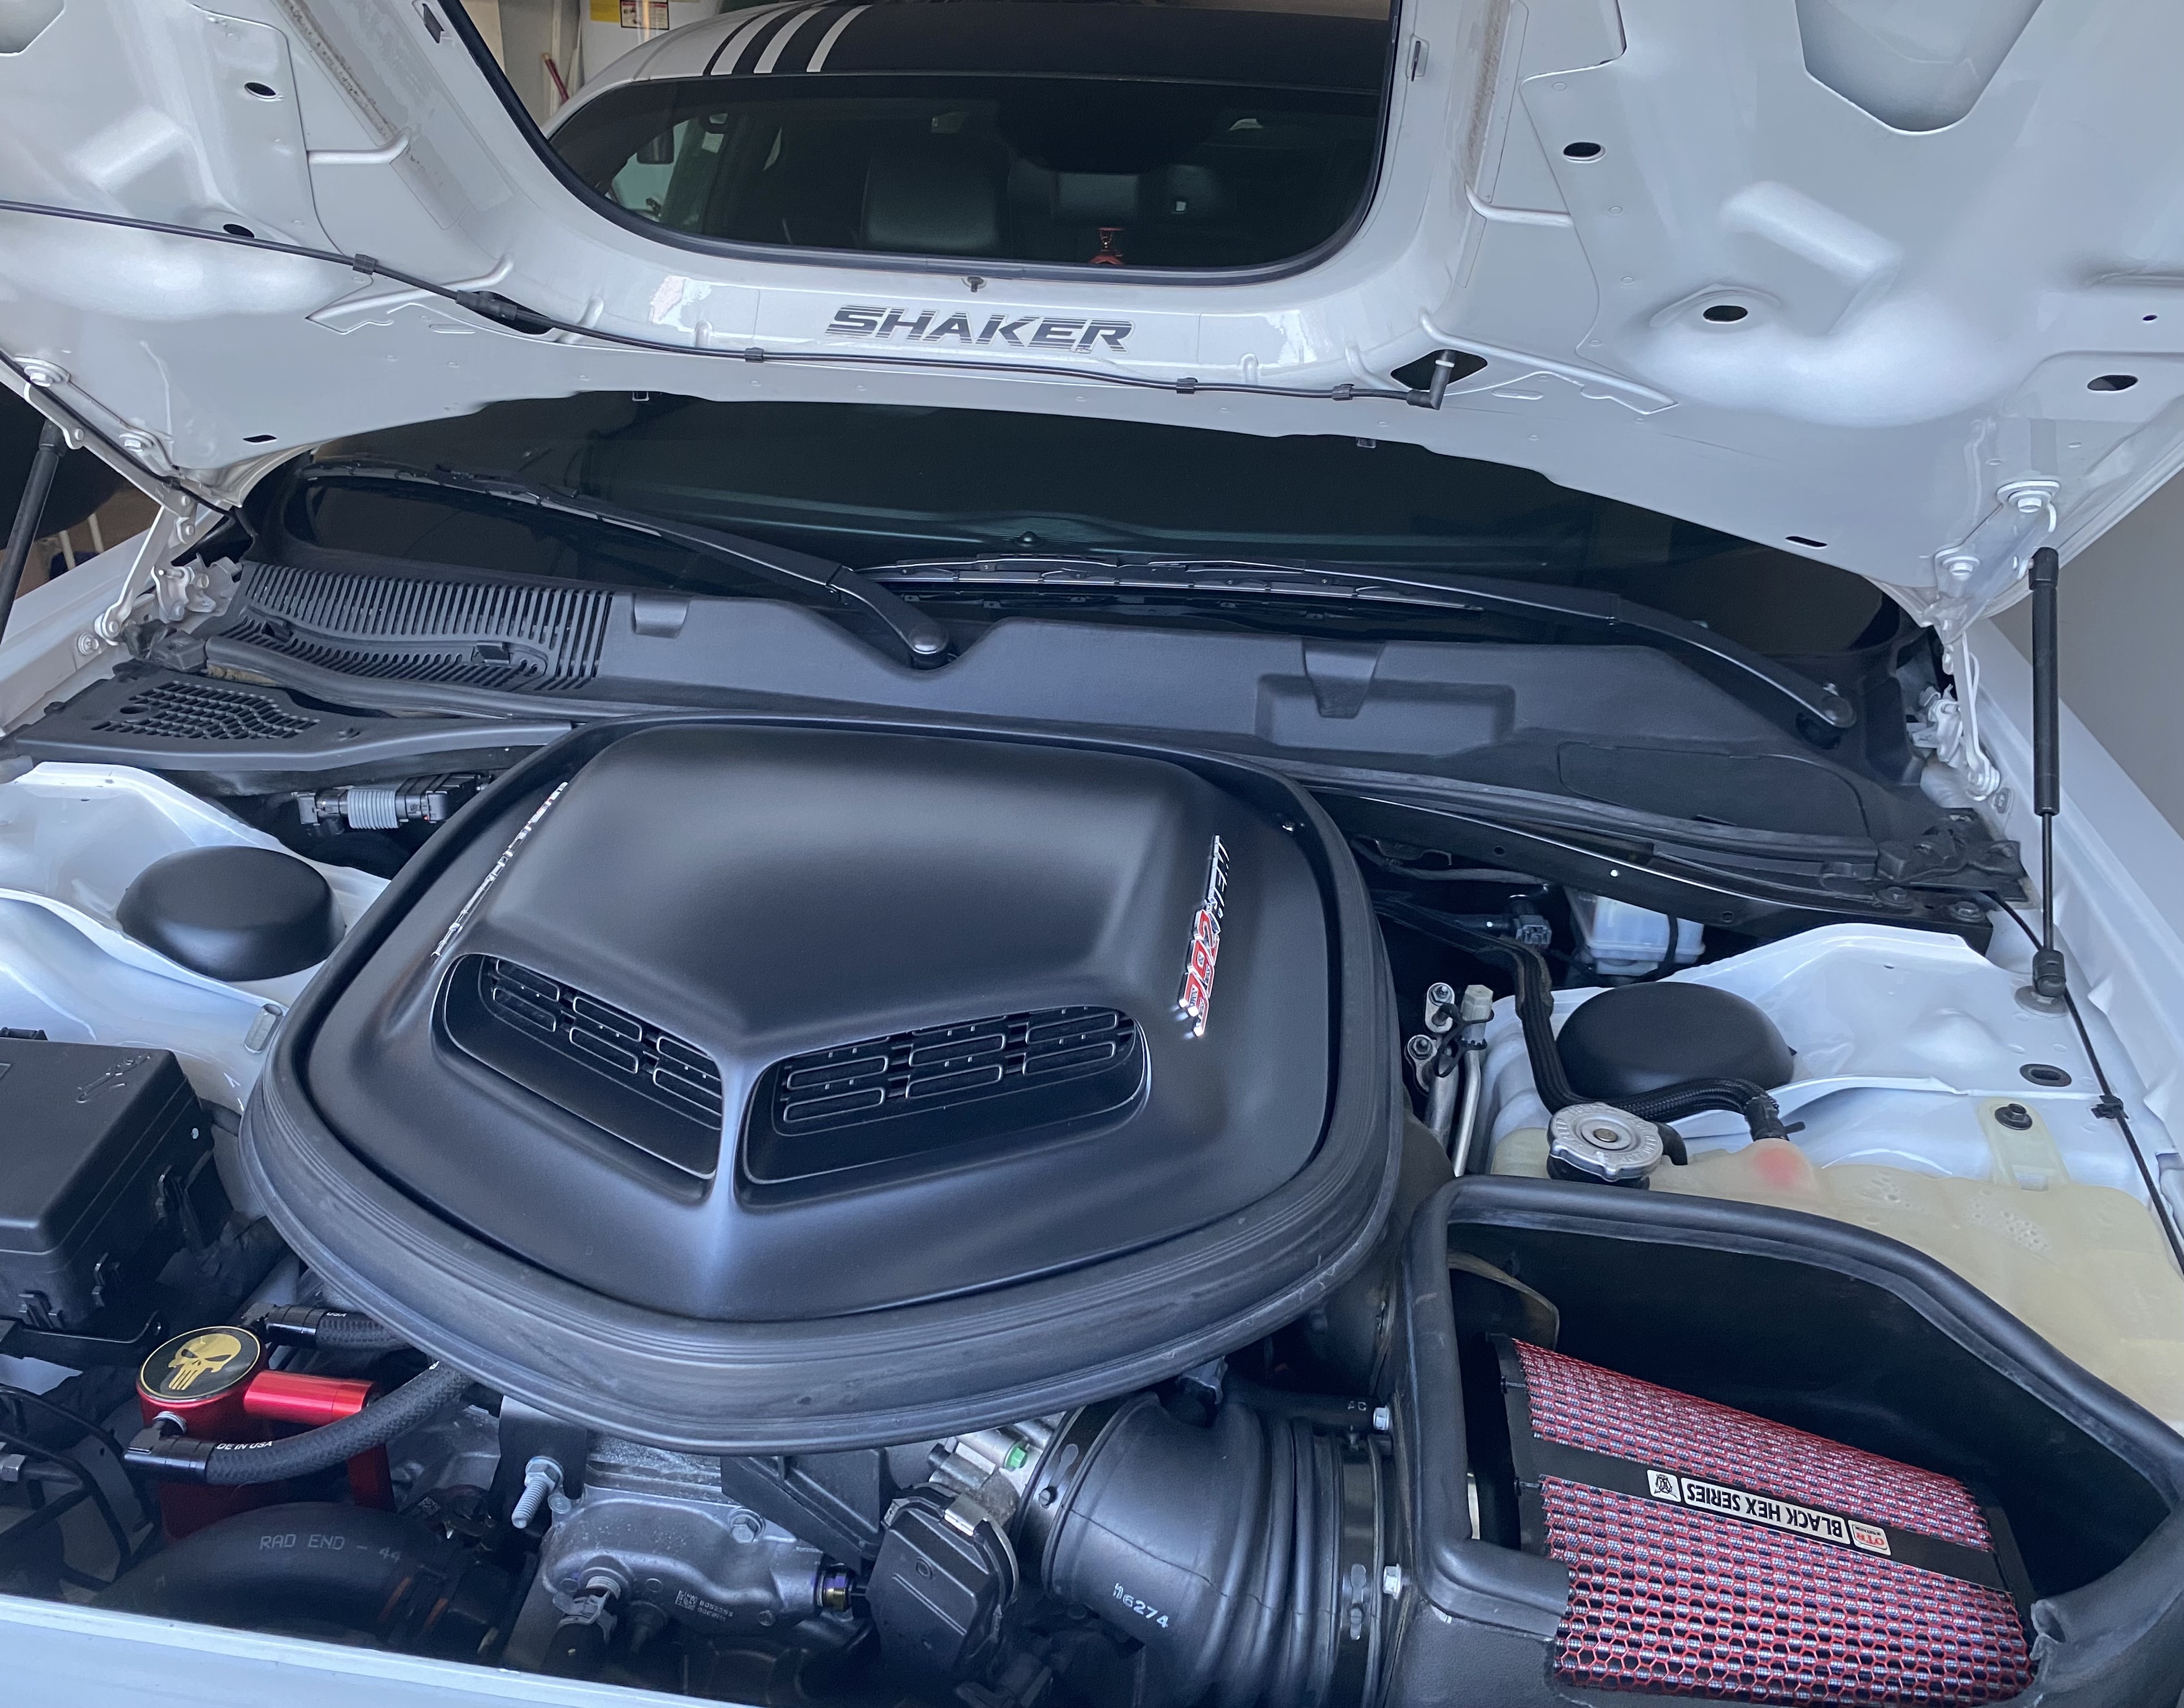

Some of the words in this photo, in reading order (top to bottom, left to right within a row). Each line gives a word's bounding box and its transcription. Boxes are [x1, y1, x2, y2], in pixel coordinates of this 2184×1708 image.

[825, 304, 1133, 354] SHAKER
[1177, 908, 1220, 1037] 392
[249, 1441, 273, 1449] USA
[1687, 1483, 1741, 1511] SERIES
[1746, 1497, 1781, 1522] HEX
[1787, 1507, 1843, 1539] BLACK
[259, 1533, 297, 1550] RAD
[307, 1534, 345, 1550] END
